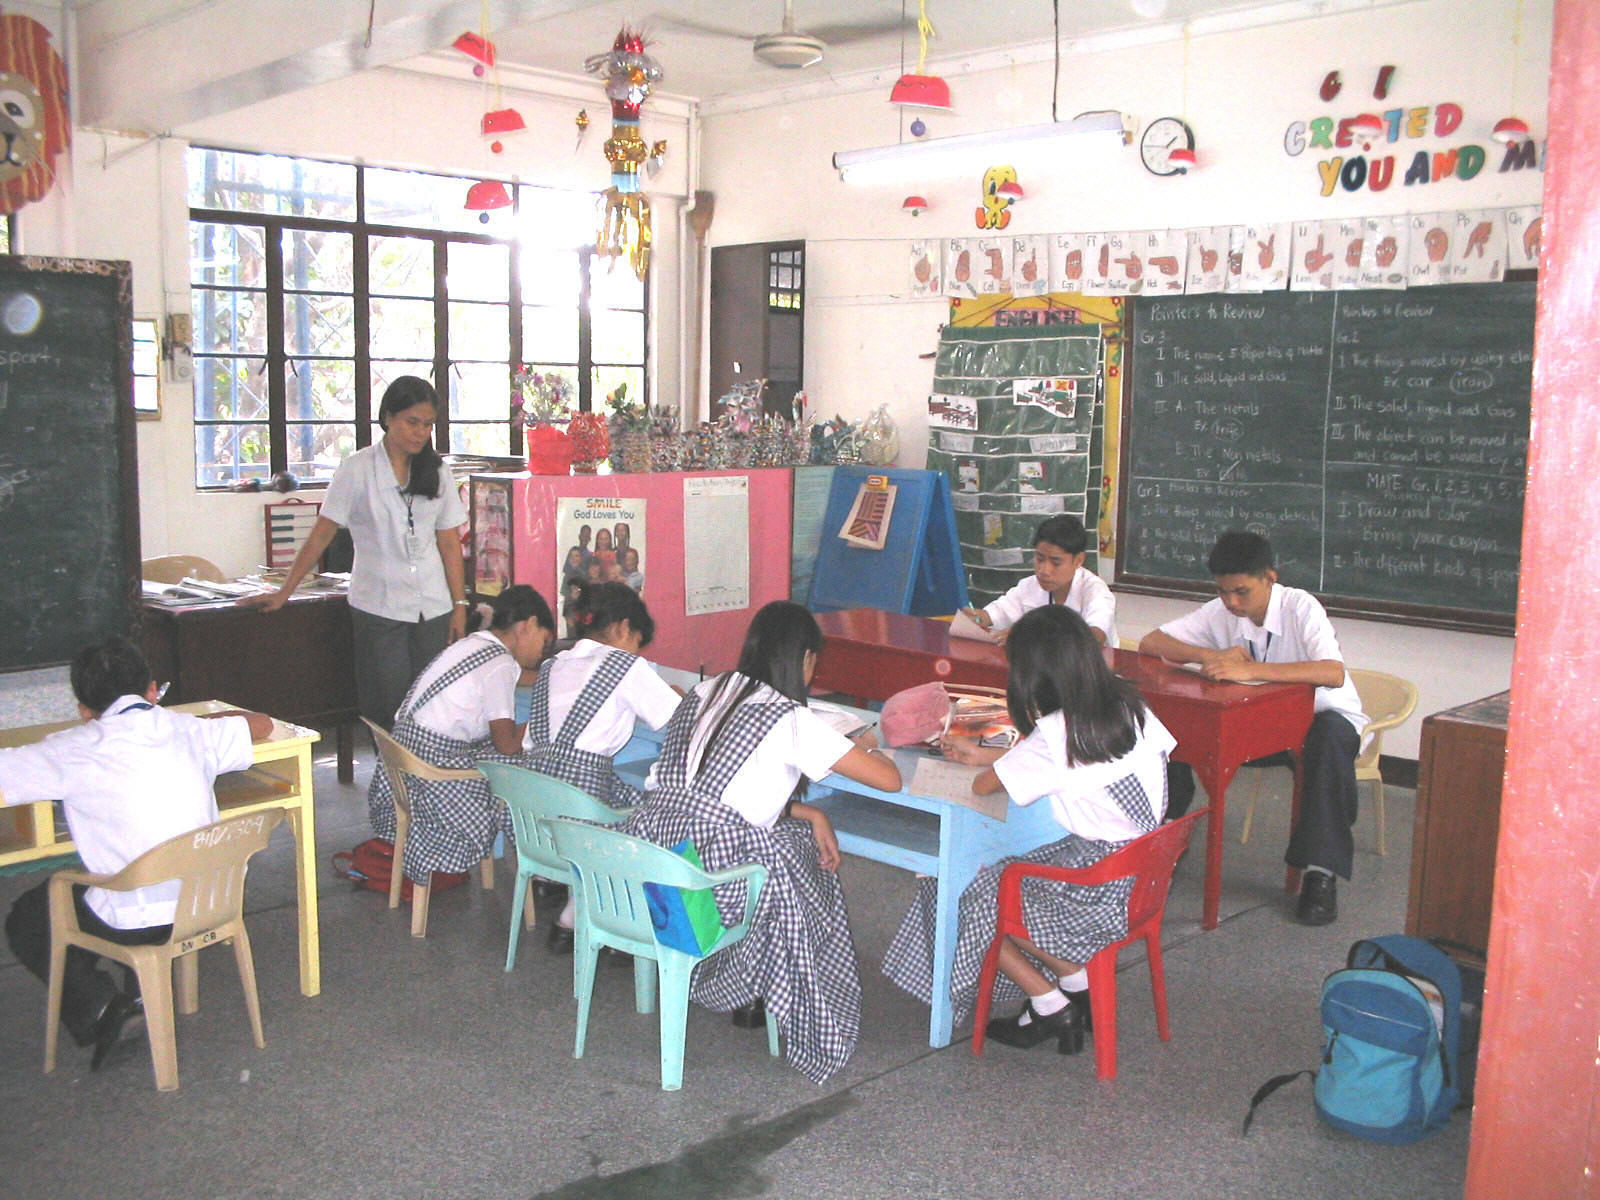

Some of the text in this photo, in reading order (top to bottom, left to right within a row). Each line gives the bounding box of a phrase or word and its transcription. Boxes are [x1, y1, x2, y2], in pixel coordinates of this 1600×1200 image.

[1284, 102, 1463, 157] CRETED
[1317, 155, 1395, 197] YOU
[1403, 144, 1485, 187] AND
[1150, 302, 1201, 322] Pointers
[1223, 302, 1267, 321] Review
[1194, 400, 1217, 415] The
[1350, 394, 1373, 412] The
[1457, 402, 1480, 417] and
[1486, 404, 1517, 418] Gas
[1354, 423, 1372, 441] The
[1419, 433, 1444, 445] can
[1469, 432, 1507, 447] moved
[586, 498, 622, 508] SMILE
[1357, 502, 1397, 518] Draw
[1402, 501, 1431, 519] and
[573, 509, 635, 520] God Loves You
[1362, 525, 1498, 556] Bring your crayon
